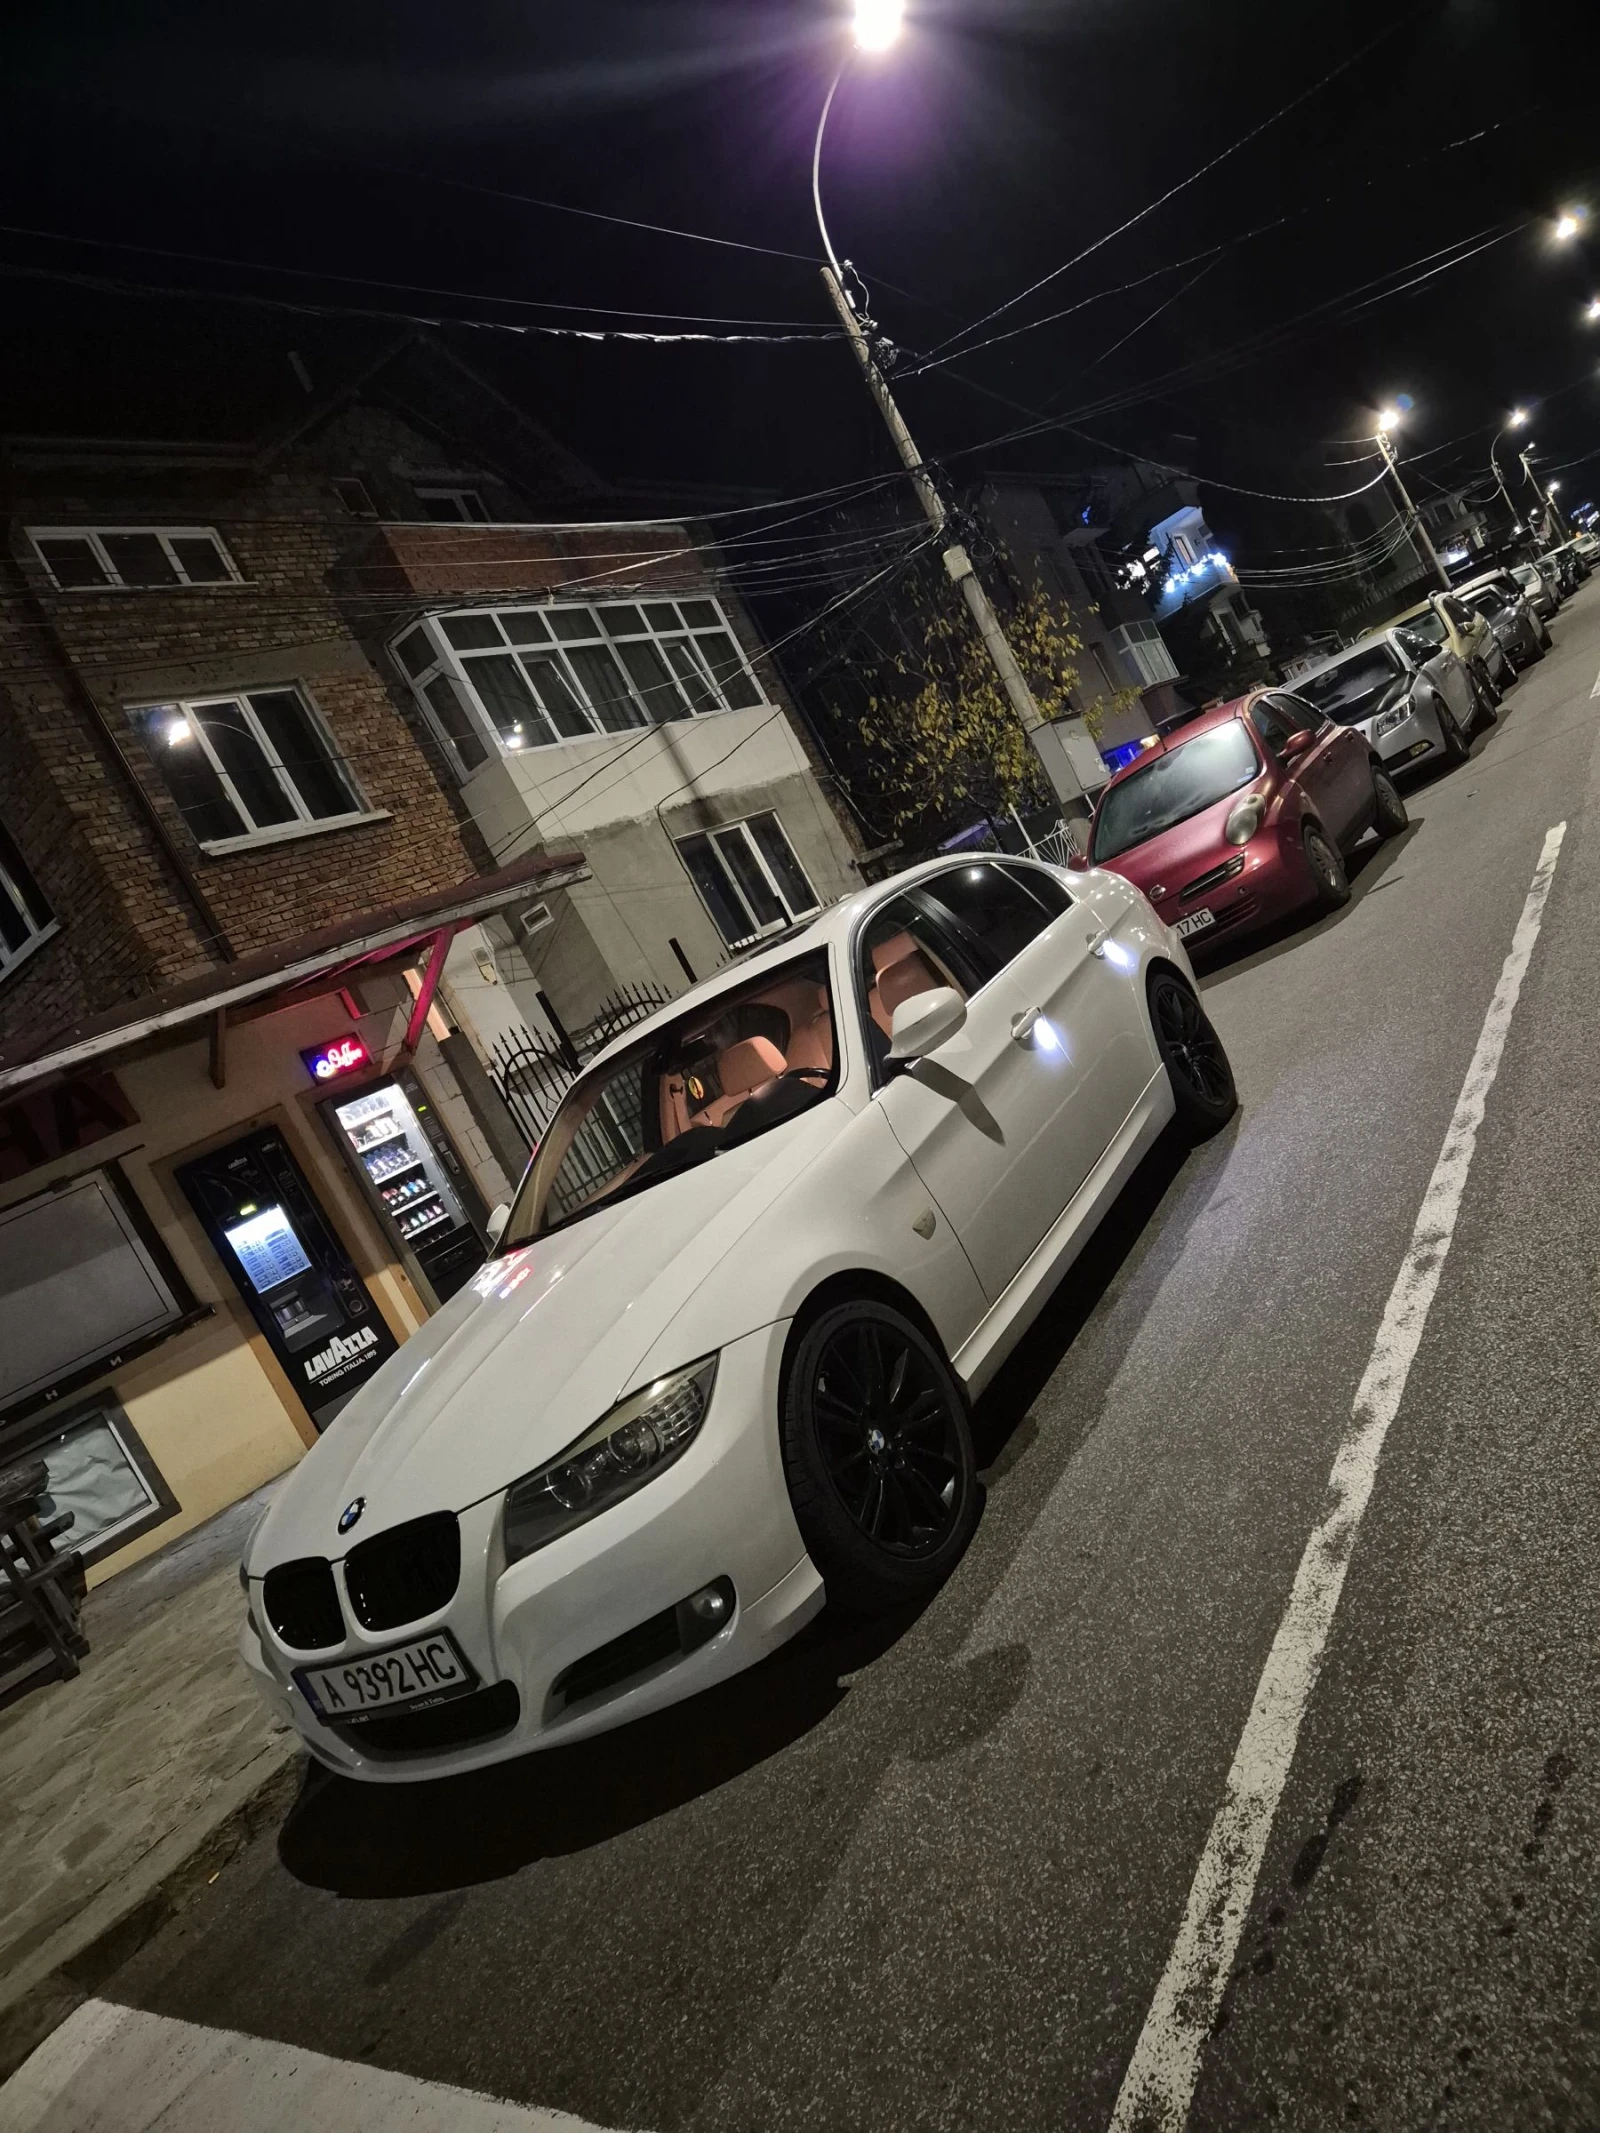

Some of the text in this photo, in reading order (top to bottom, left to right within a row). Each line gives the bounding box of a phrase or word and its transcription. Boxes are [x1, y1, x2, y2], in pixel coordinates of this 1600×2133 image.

[1176, 911, 1212, 936] 17 HC
[303, 1326, 379, 1381] LAVAZZA
